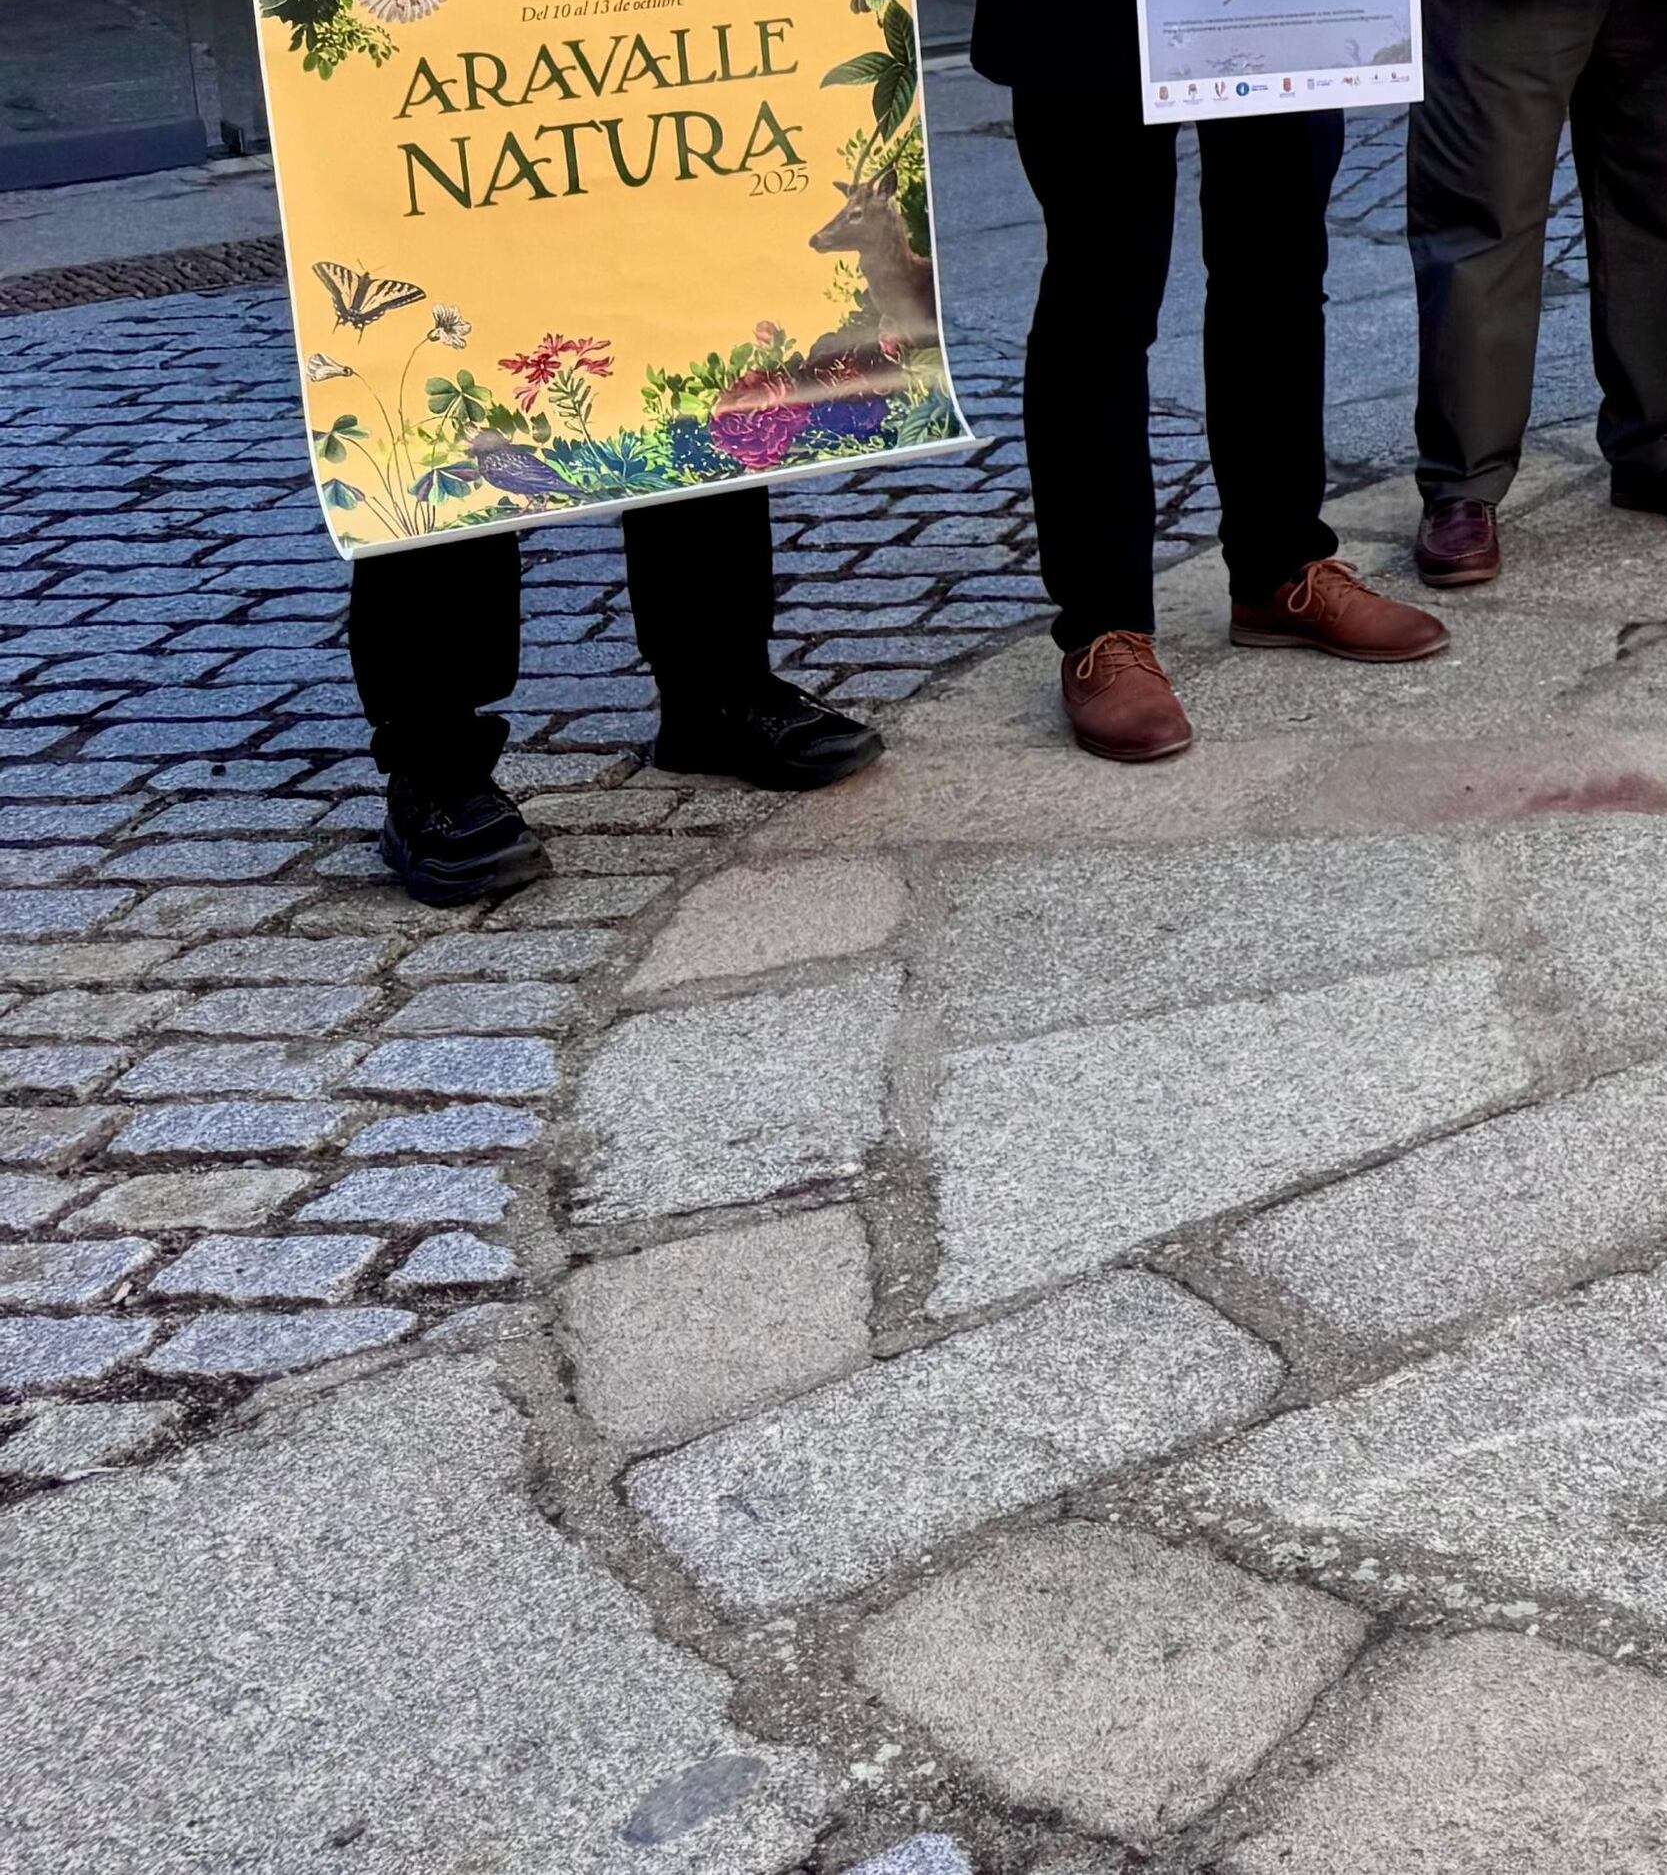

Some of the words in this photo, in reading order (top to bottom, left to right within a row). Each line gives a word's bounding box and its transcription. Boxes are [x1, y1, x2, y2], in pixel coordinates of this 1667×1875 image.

[522, 5, 549, 22] Del
[553, 3, 571, 19] 10
[574, 0, 588, 16] al
[593, 0, 609, 14] 13
[392, 17, 799, 120] ARAVALLE
[397, 100, 807, 217] NATURA
[748, 166, 810, 197] 2025
